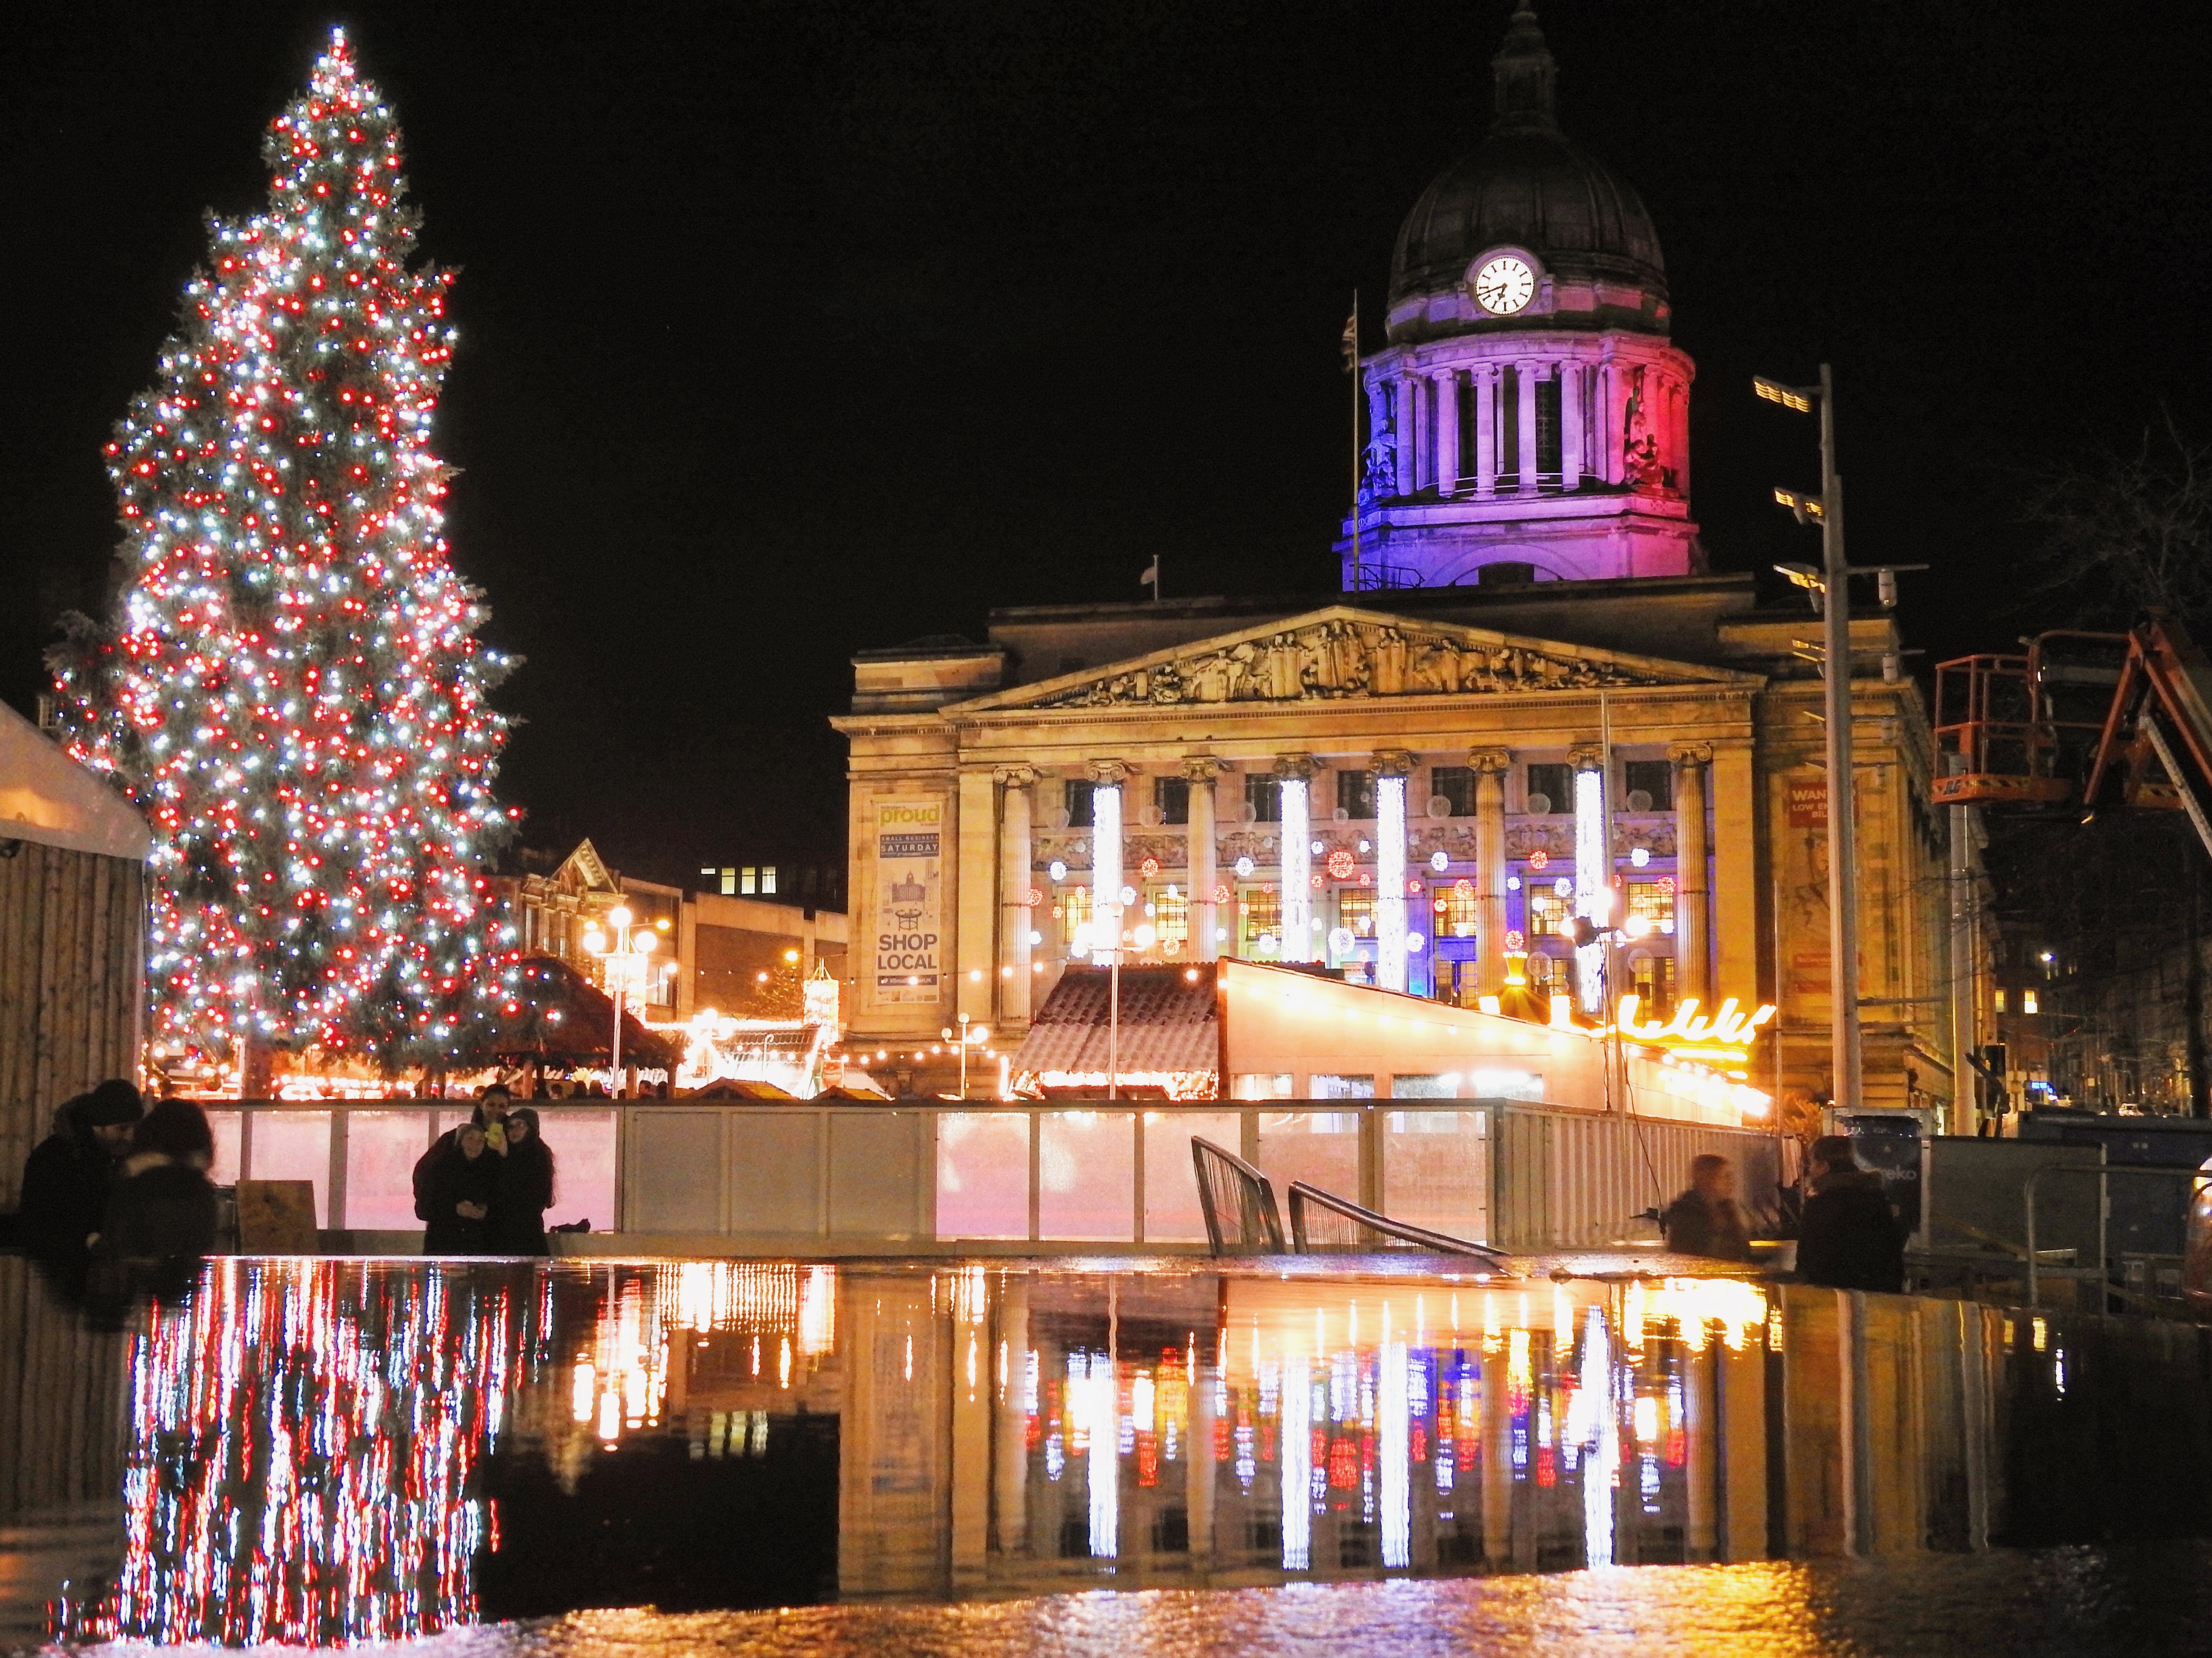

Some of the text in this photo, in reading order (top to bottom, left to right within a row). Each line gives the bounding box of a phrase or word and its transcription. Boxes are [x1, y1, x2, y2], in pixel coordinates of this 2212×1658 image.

[1792, 803, 1815, 811] LOW
[880, 804, 940, 827] proud
[881, 844, 938, 852] SATURDAY
[879, 933, 938, 952] SHOP
[877, 954, 937, 970] LOCAL
